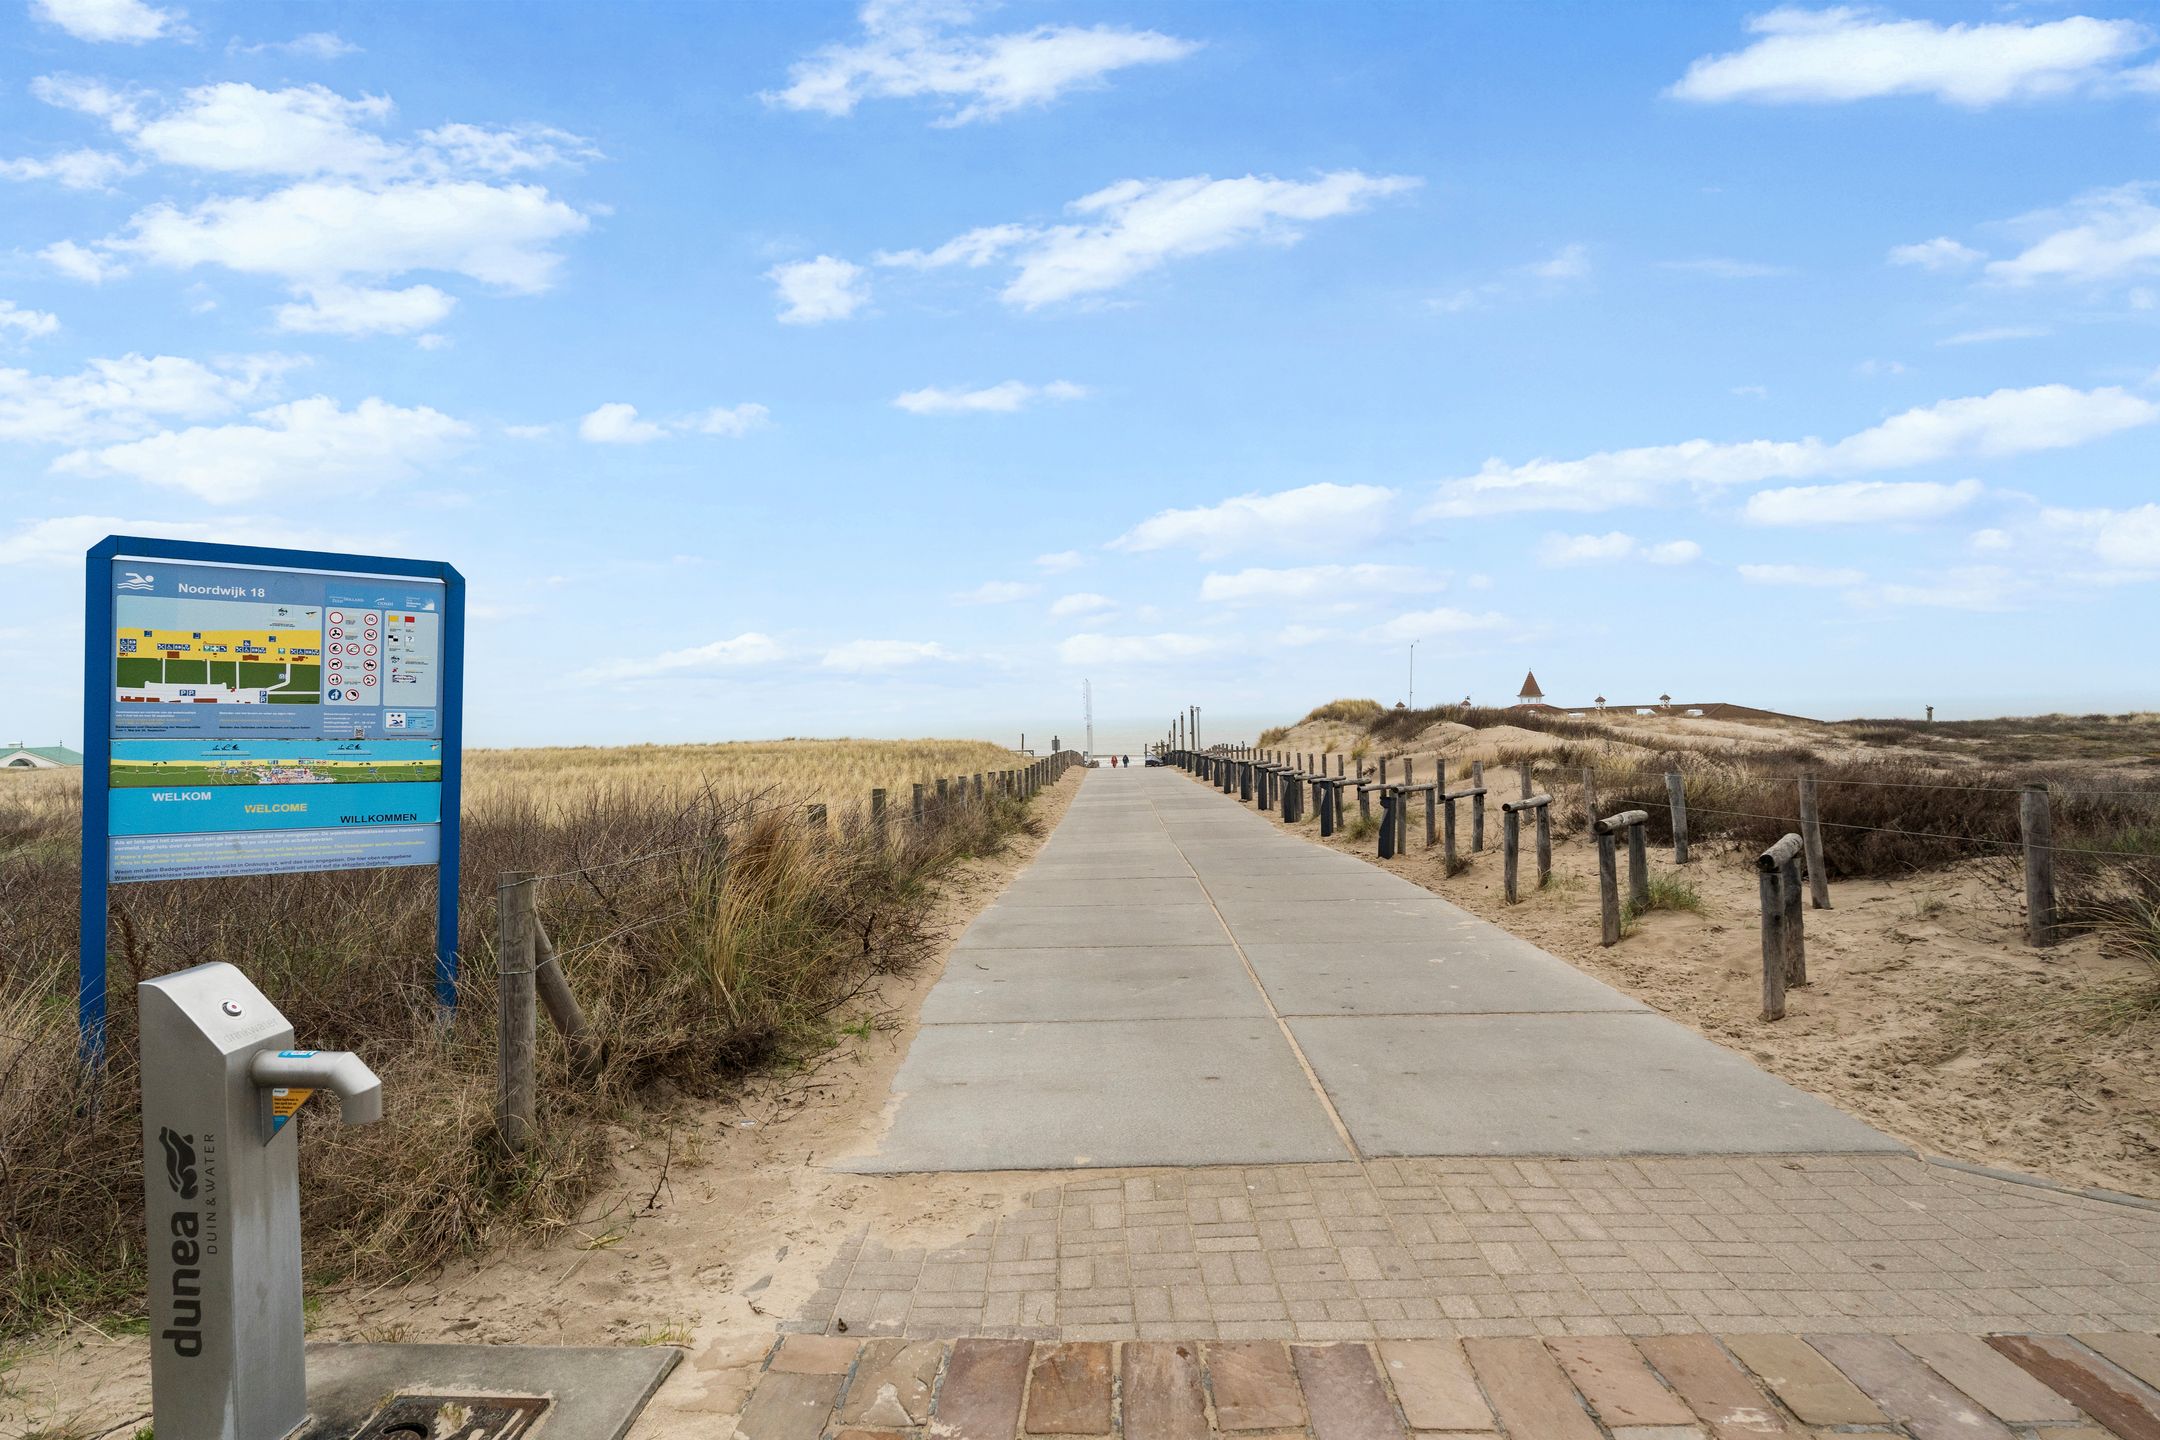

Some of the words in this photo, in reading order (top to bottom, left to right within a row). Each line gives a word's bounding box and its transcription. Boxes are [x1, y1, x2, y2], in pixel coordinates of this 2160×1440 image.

[178, 583, 246, 599] Noordwijk
[250, 588, 265, 598] 18
[152, 791, 212, 802] WELKOM
[244, 803, 308, 814] WELCOME
[340, 813, 417, 824] WILLKOMMEN
[224, 1017, 279, 1043] drinkwater
[203, 1133, 216, 1196] WATER
[205, 1197, 217, 1206] &
[206, 1212, 218, 1255] DUIN
[162, 1211, 202, 1357] dunea
